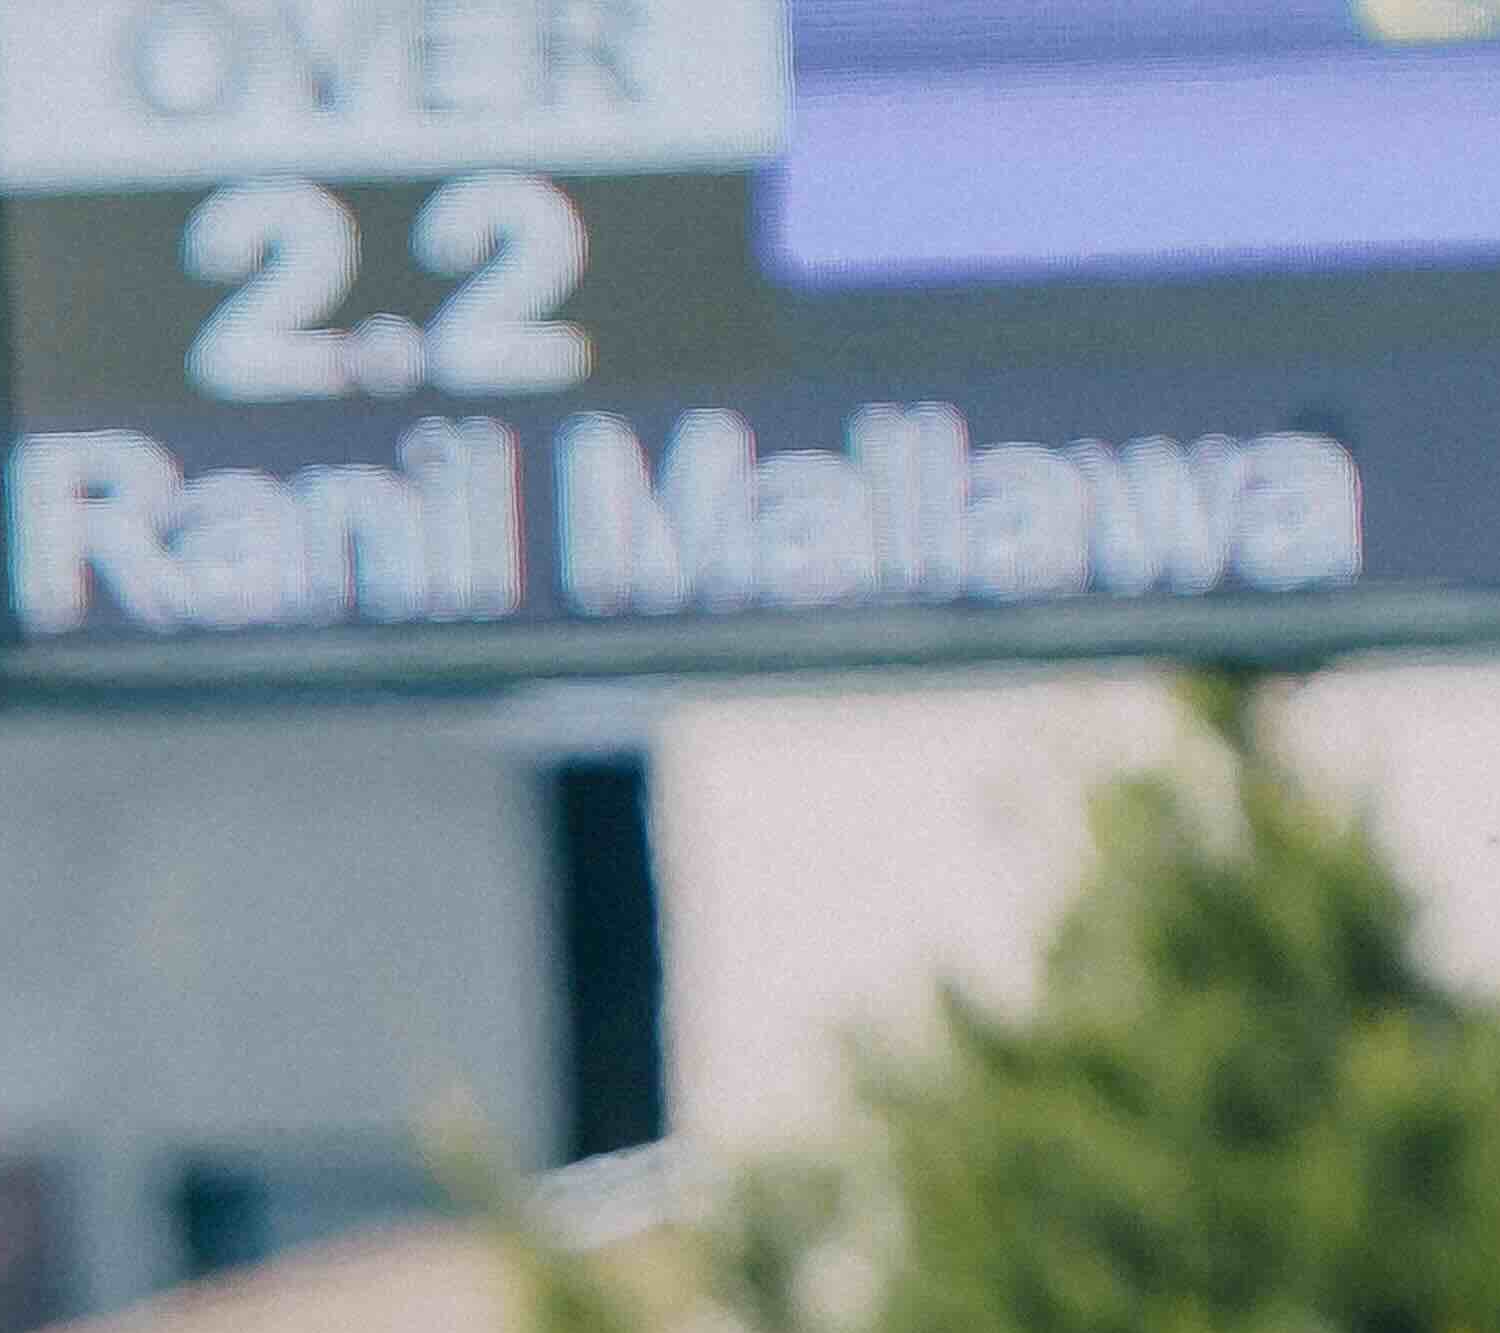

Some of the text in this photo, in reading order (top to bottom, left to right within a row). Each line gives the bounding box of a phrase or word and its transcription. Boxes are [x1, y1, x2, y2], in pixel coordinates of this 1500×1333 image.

[125, 0, 645, 122] OVER
[181, 168, 594, 400] 2.2
[4, 400, 1363, 634] Ranil Mallawa
